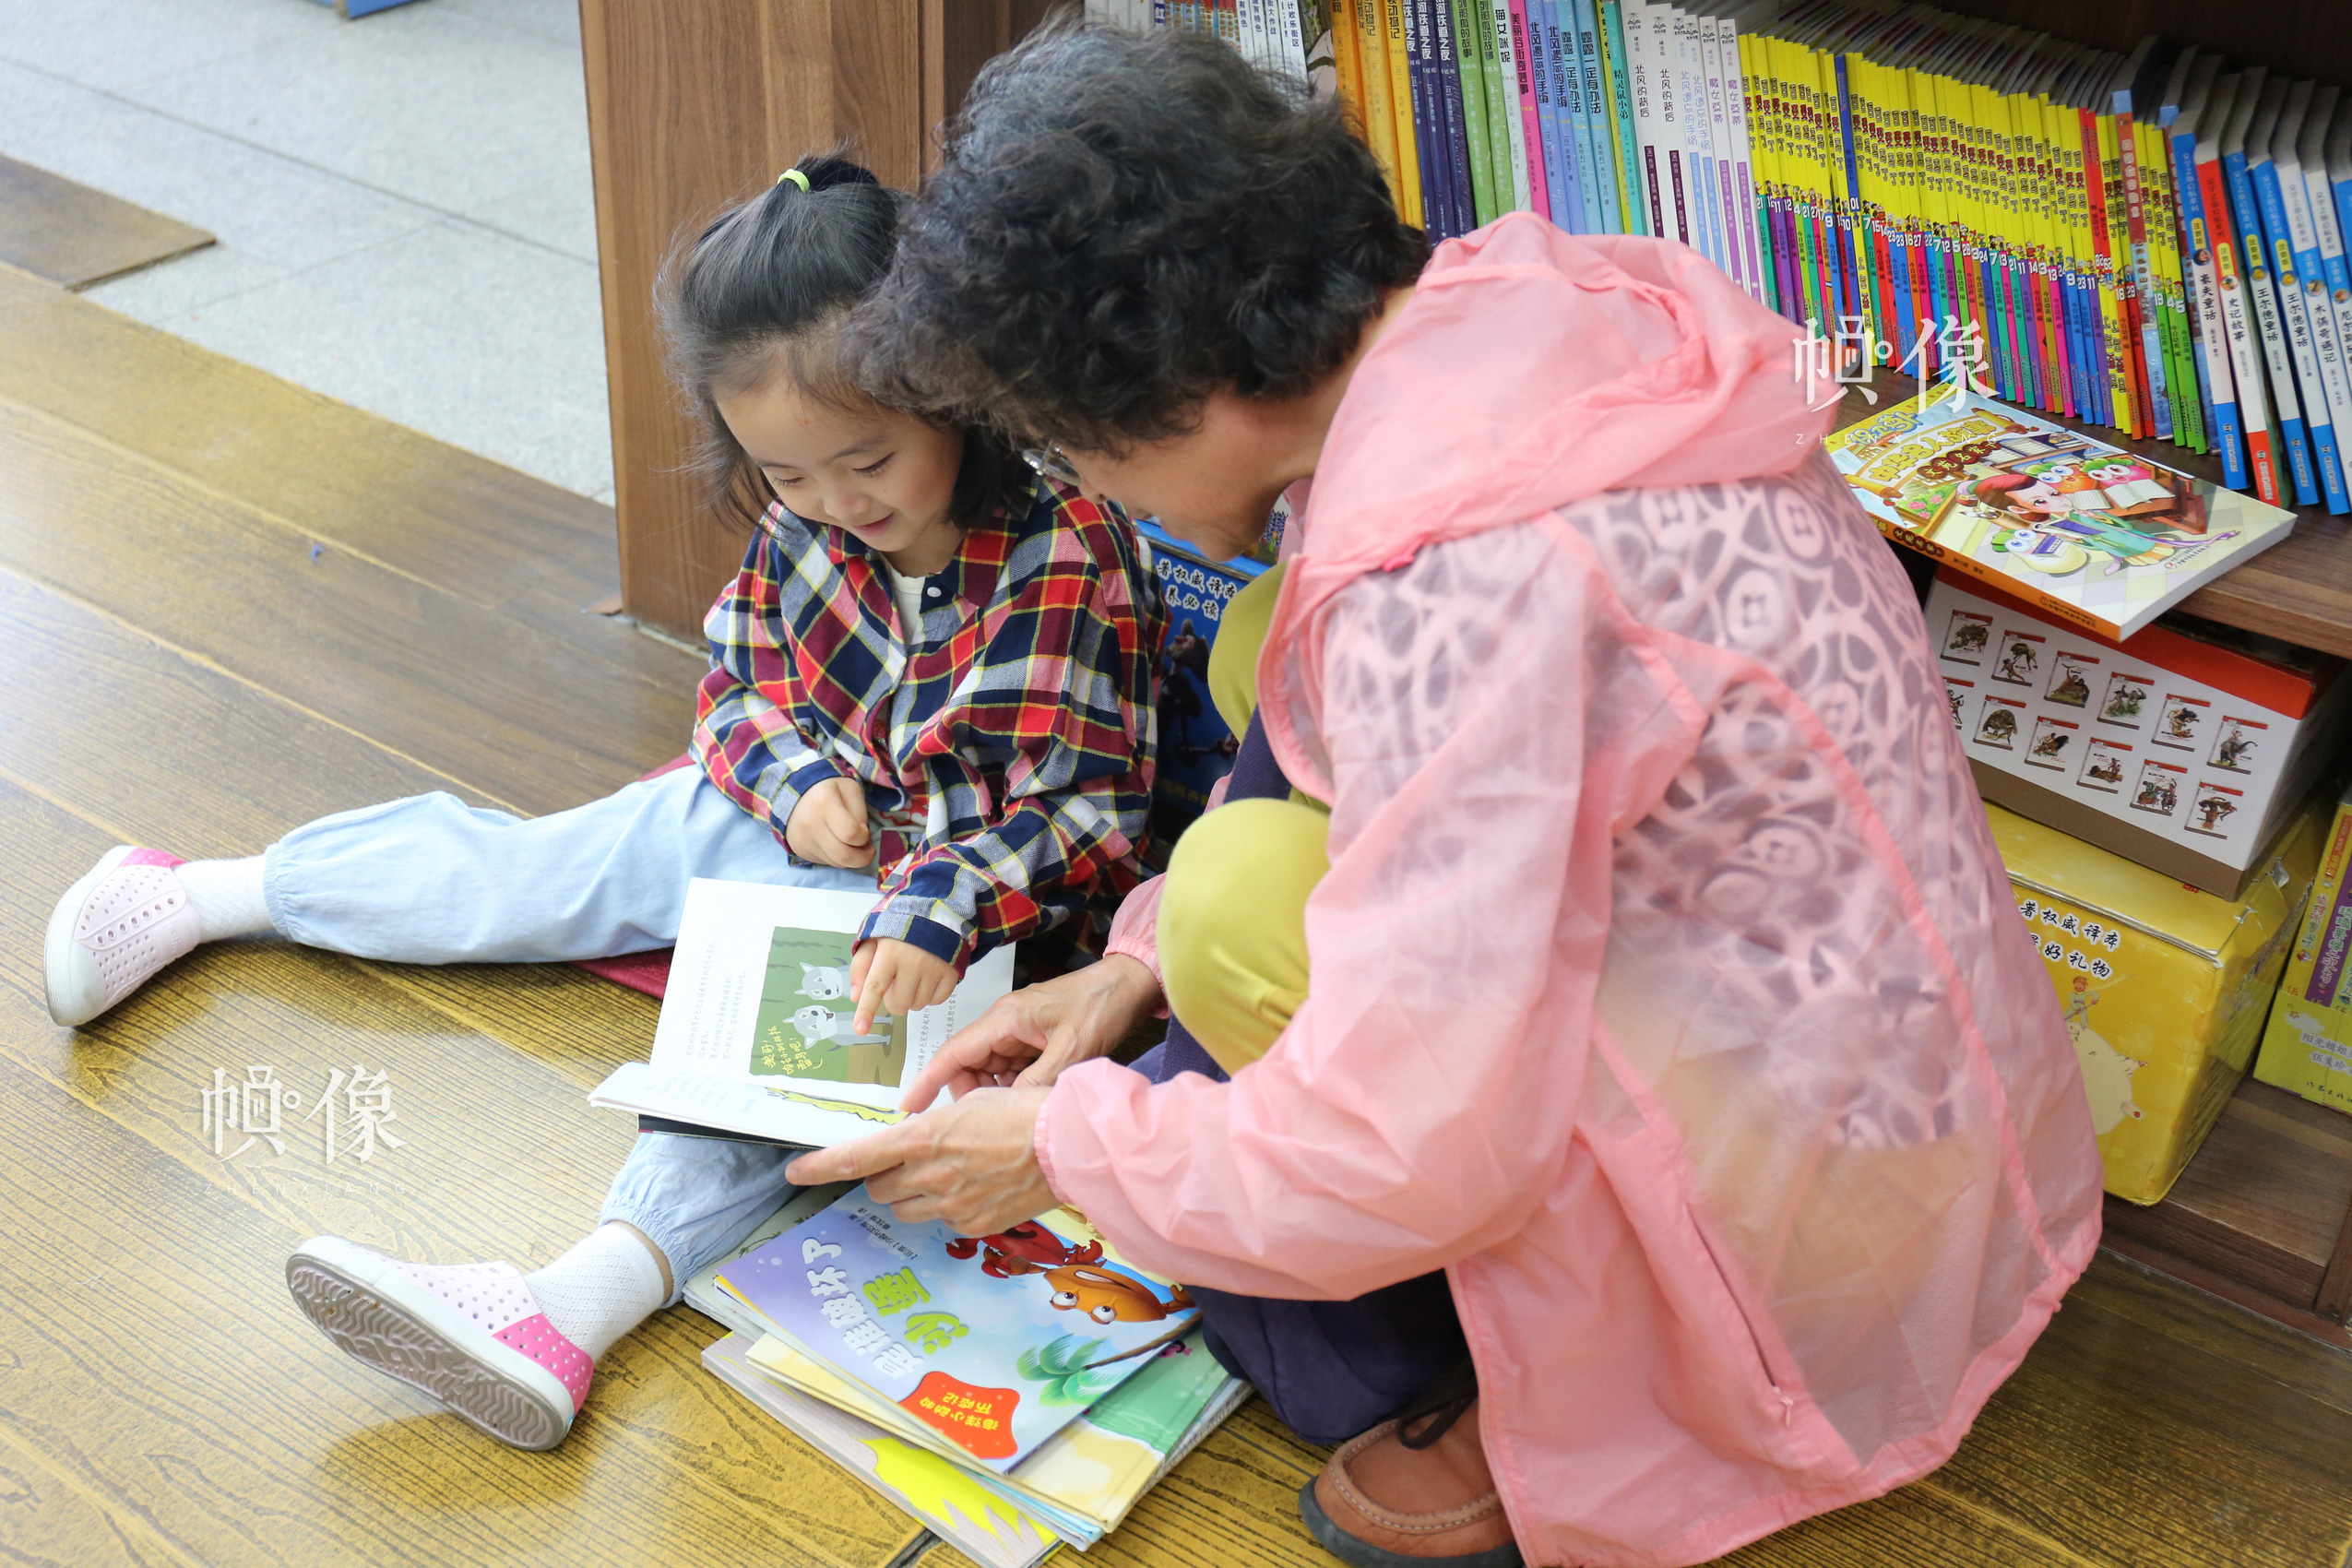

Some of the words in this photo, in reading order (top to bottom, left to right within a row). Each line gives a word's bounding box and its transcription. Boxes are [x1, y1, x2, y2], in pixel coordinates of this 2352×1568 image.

[1416, 0, 1431, 59] 河铁道之夜
[1434, 0, 1451, 61] 河铁道之夜
[1495, 9, 1511, 64] 猫女咪妮
[1613, 69, 1629, 120] 精灵鼠小弟
[1635, 65, 1650, 118] 北风的背后
[1660, 68, 1675, 123] 北风的背后
[1825, 215, 1834, 229] 9
[1864, 217, 1871, 230] 7
[1887, 230, 1896, 243] 23
[1895, 234, 1905, 247] 23
[1905, 233, 1913, 246] 16
[1913, 233, 1922, 247] 27
[1924, 233, 1932, 247] 22
[1942, 240, 1950, 253] 12
[1952, 239, 1960, 252] 5
[1962, 243, 1971, 256] 28
[1972, 247, 1980, 260] 3
[1979, 249, 1989, 263] 24
[1990, 252, 1999, 266] 7
[1999, 253, 2008, 267] 13
[2009, 257, 2017, 270] 21
[2029, 260, 2038, 274] 14
[2048, 268, 2057, 281] 13
[2067, 273, 2076, 286] 9
[2077, 277, 2086, 291] 23
[2115, 288, 2125, 301] 16
[2127, 285, 2136, 299] 29
[2155, 292, 2164, 306] 19
[2200, 274, 2216, 321] 豪夫童话
[2176, 300, 2186, 313] 5
[2228, 297, 2244, 342] 史记故事
[2258, 288, 2279, 342] 王尔德童话
[2287, 292, 2309, 348] 王尔德童话
[2314, 303, 2336, 363] 木偶奇遇记
[1868, 418, 1997, 482] 中华名人故事
[1166, 585, 1224, 622] 养必读
[2313, 1053, 2352, 1076] 伍美珍
[801, 1237, 923, 1381] 是谁破坏了
[861, 1265, 969, 1358] 沙堡
[944, 1390, 993, 1416] 历险记
[919, 1397, 999, 1432] 海洋小动物
